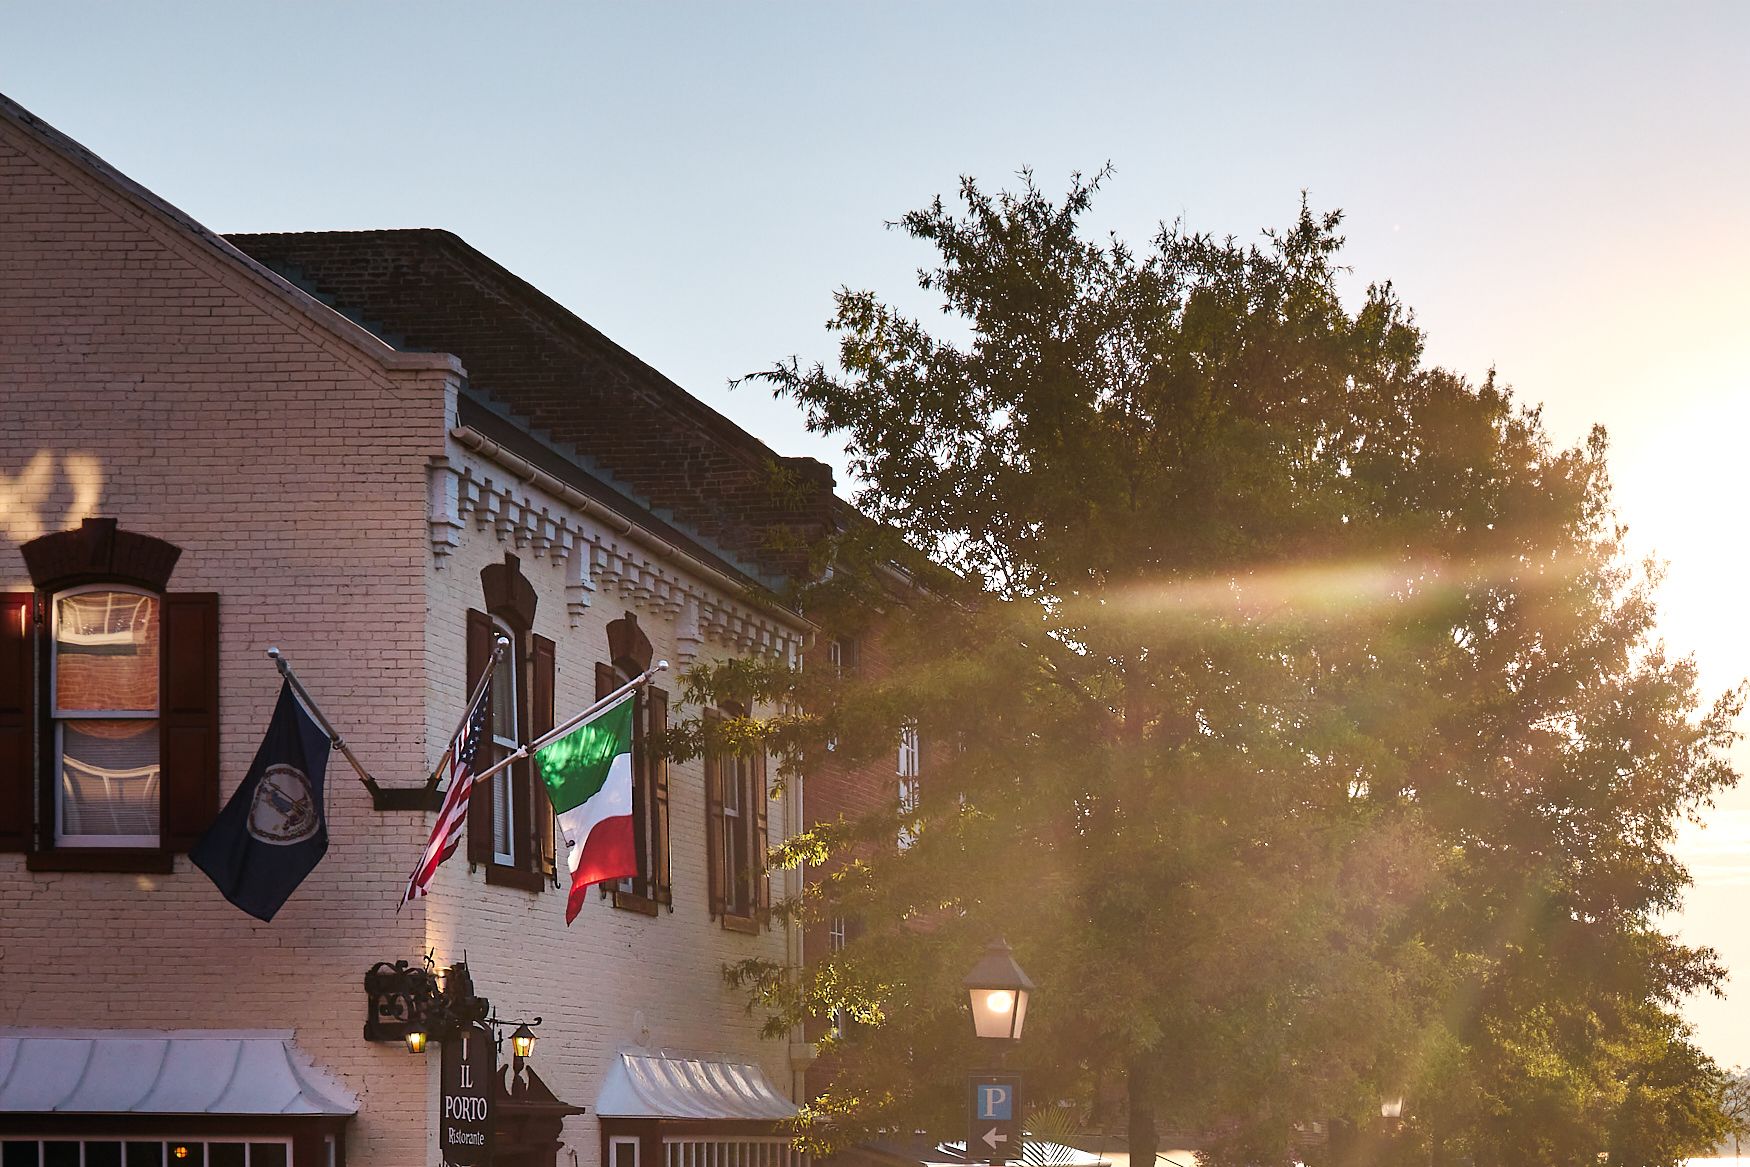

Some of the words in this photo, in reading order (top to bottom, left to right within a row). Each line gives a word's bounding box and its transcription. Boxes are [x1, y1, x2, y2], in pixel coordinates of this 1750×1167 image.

[460, 1064, 474, 1088] IL
[445, 1095, 487, 1122] PORTO
[983, 1088, 1006, 1117] P
[448, 1127, 485, 1146] Ristorante
